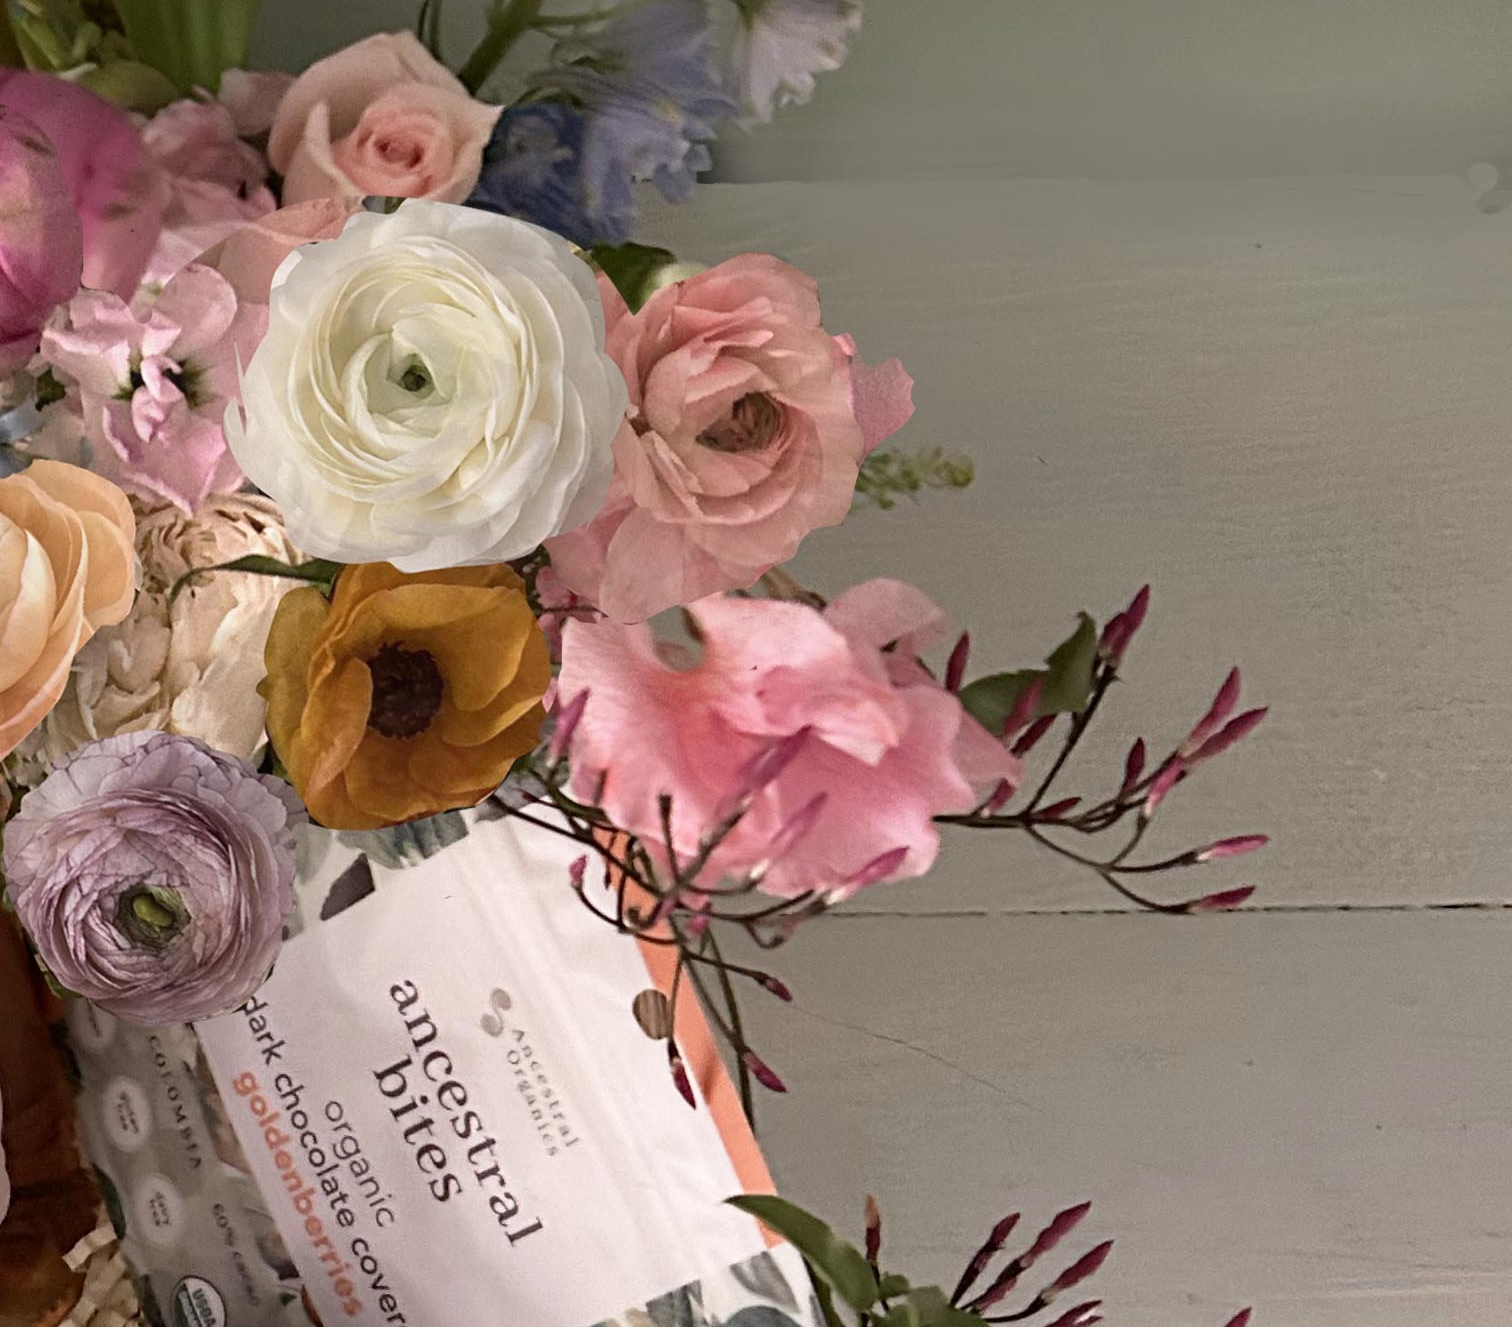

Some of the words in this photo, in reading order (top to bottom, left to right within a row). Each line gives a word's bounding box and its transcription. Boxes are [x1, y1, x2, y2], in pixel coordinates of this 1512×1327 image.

[243, 995, 286, 1065] dark
[274, 1072, 356, 1227] chocolate
[373, 1054, 462, 1202] bites
[389, 979, 543, 1247] ancestral
[506, 1049, 559, 1156] Organics
[511, 1028, 580, 1147] Ancestral
[232, 1070, 363, 1317] goldenberries
[324, 1100, 395, 1227] organic
